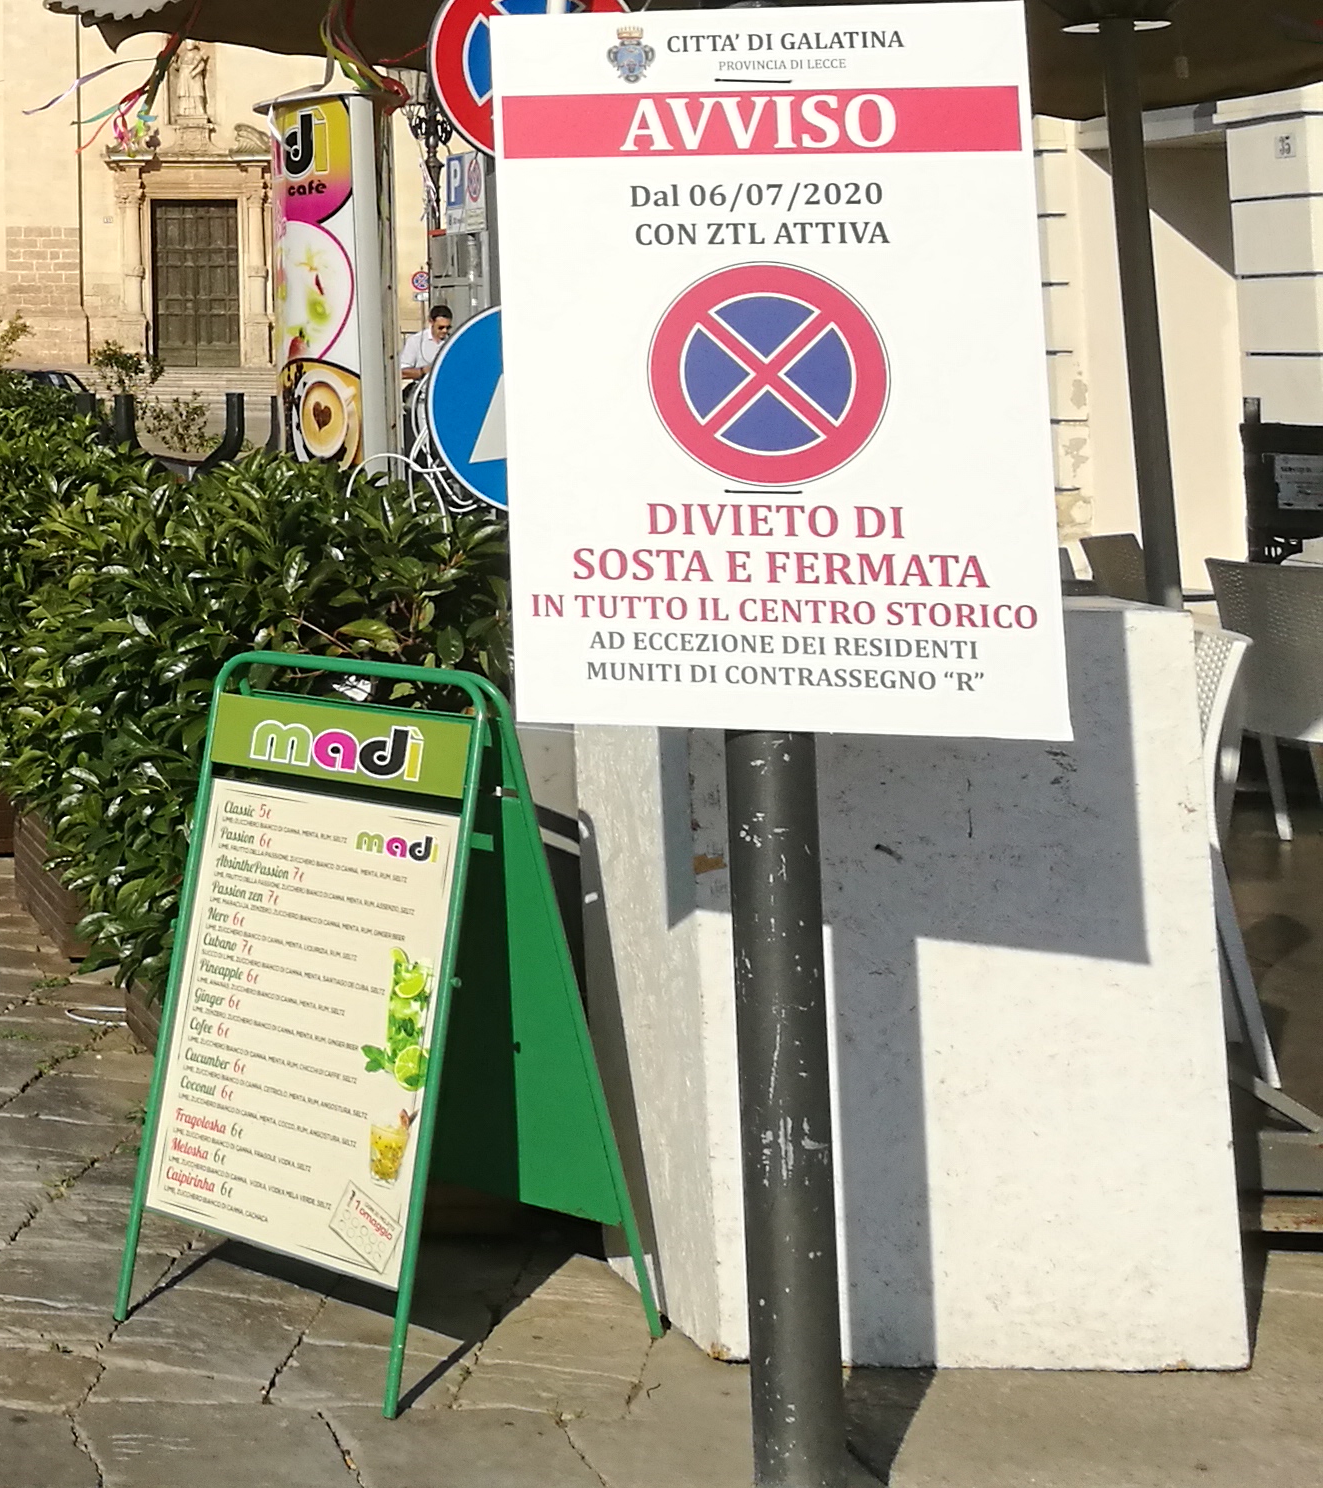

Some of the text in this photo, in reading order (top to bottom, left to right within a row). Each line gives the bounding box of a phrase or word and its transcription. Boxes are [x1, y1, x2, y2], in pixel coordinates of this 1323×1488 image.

[748, 33, 773, 52] DI
[781, 30, 904, 51] GALATINA
[718, 59, 847, 71] PROVINCIA DI LECCE
[619, 94, 897, 151] AVVISO
[288, 179, 327, 197] cafè
[449, 160, 461, 202] P
[630, 181, 883, 212] Dal 06/07/2020
[635, 222, 890, 246] CON ZTL ATTIVA
[648, 502, 905, 539] DIVIETO DI
[573, 548, 990, 588] SOSTA E FERMATA
[531, 594, 1038, 629] IN TUTTO IL CENTRO STORICO
[590, 631, 978, 660] AD ECCEZIONE DEI RESIDENTI
[587, 661, 681, 683] MUNITI
[690, 664, 717, 684] DI
[725, 666, 936, 691] CONTRASSEGNO
[224, 800, 255, 817] Classic
[221, 827, 254, 844] Passion
[212, 880, 247, 898] Passion
[248, 891, 263, 902] zen
[208, 907, 229, 923] Nero
[203, 933, 237, 951] Cubano
[199, 958, 243, 981] Pineapple
[195, 988, 225, 1007] Ginger
[185, 1048, 230, 1070] Cucumber
[180, 1075, 216, 1096] Coconut
